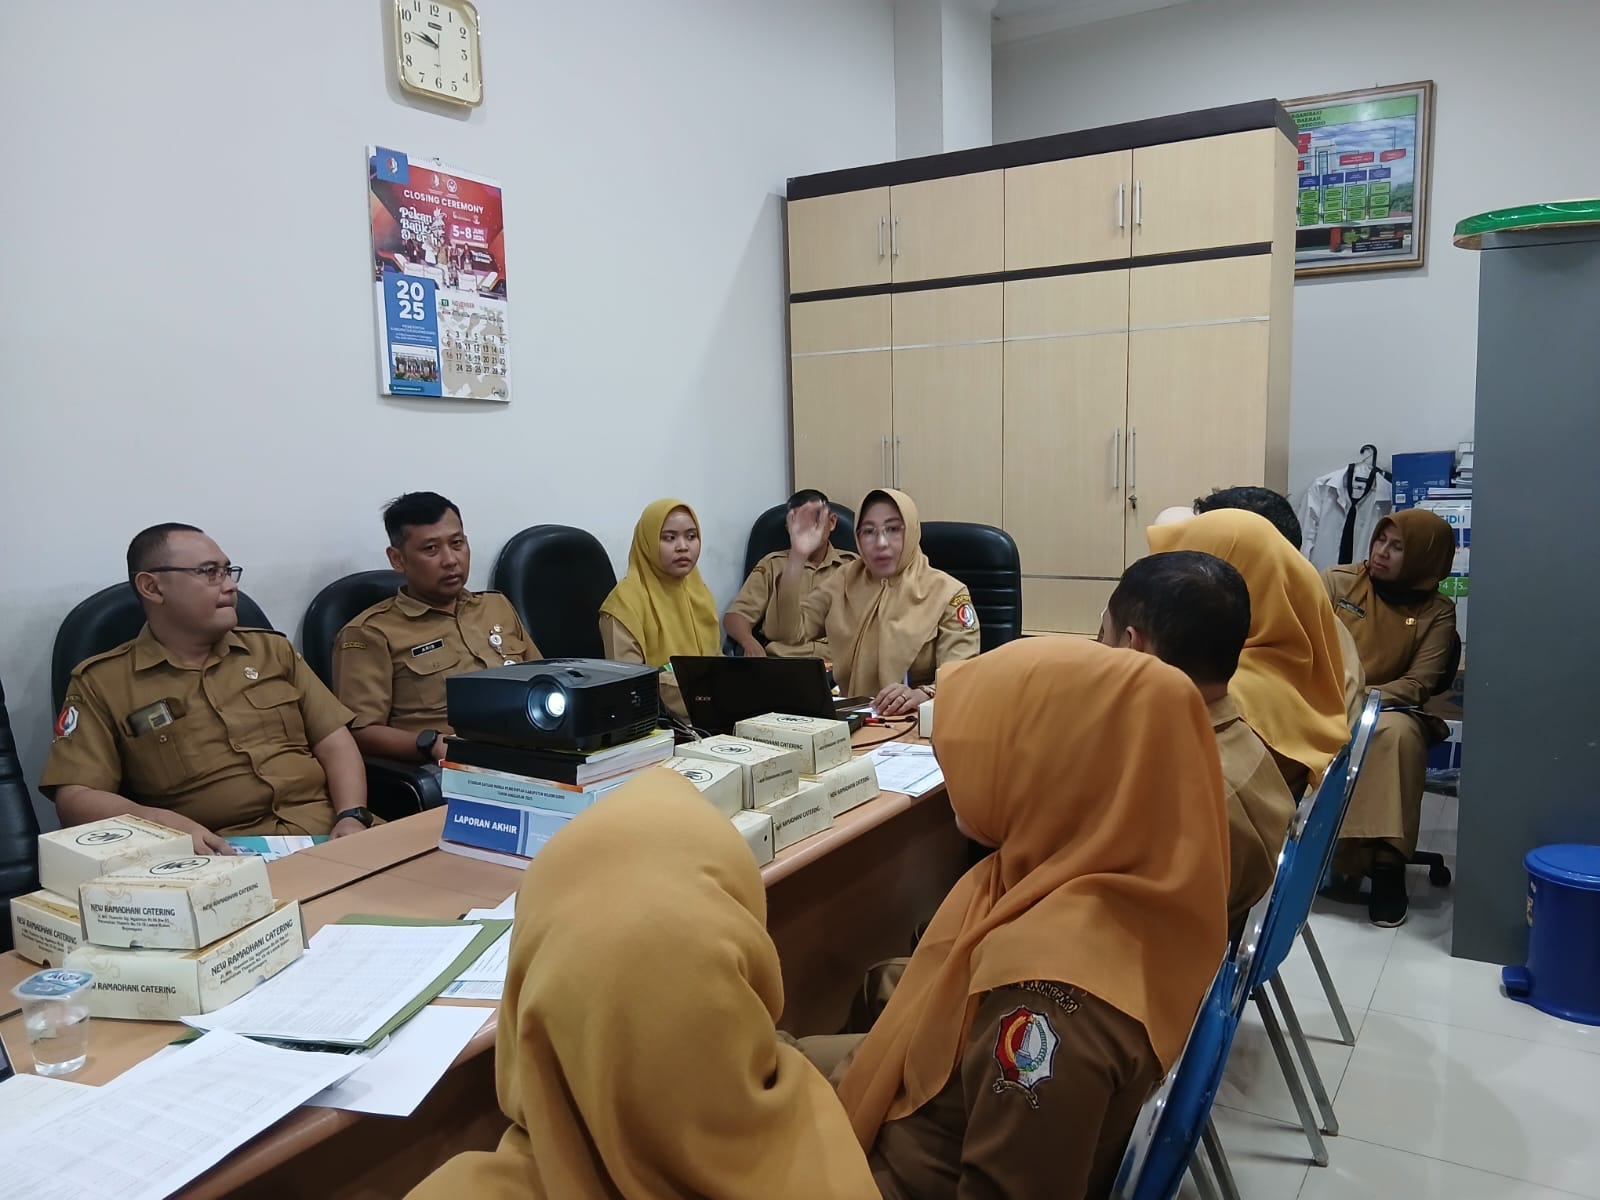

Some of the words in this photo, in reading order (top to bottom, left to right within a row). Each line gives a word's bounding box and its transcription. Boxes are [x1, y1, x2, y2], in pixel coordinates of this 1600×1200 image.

[401, 9, 412, 22] 10
[430, 4, 440, 18] 12
[404, 32, 412, 45] 9
[459, 26, 467, 40] 2
[405, 54, 413, 67] 8
[461, 49, 468, 61] 3
[418, 71, 425, 83] 7
[435, 77, 443, 89] 6
[462, 72, 469, 84] 4
[451, 80, 458, 92] 5
[403, 189, 440, 205] CLOSING
[441, 198, 484, 214] CEREMONY
[399, 206, 433, 225] Pekan
[396, 280, 425, 301] 20
[398, 300, 425, 321] 25
[1440, 514, 1465, 524] iDU
[453, 814, 491, 829] LAPORAN
[491, 821, 517, 835] AKHIR
[90, 903, 104, 912] NEW
[104, 904, 141, 915] RAMADHANI
[142, 907, 176, 917] CATERING
[211, 959, 227, 977] NEW
[227, 936, 265, 967] RAMADHANI
[265, 918, 294, 942] CATERING
[98, 982, 140, 993] RAMADHANI
[140, 984, 177, 994] CATERING
